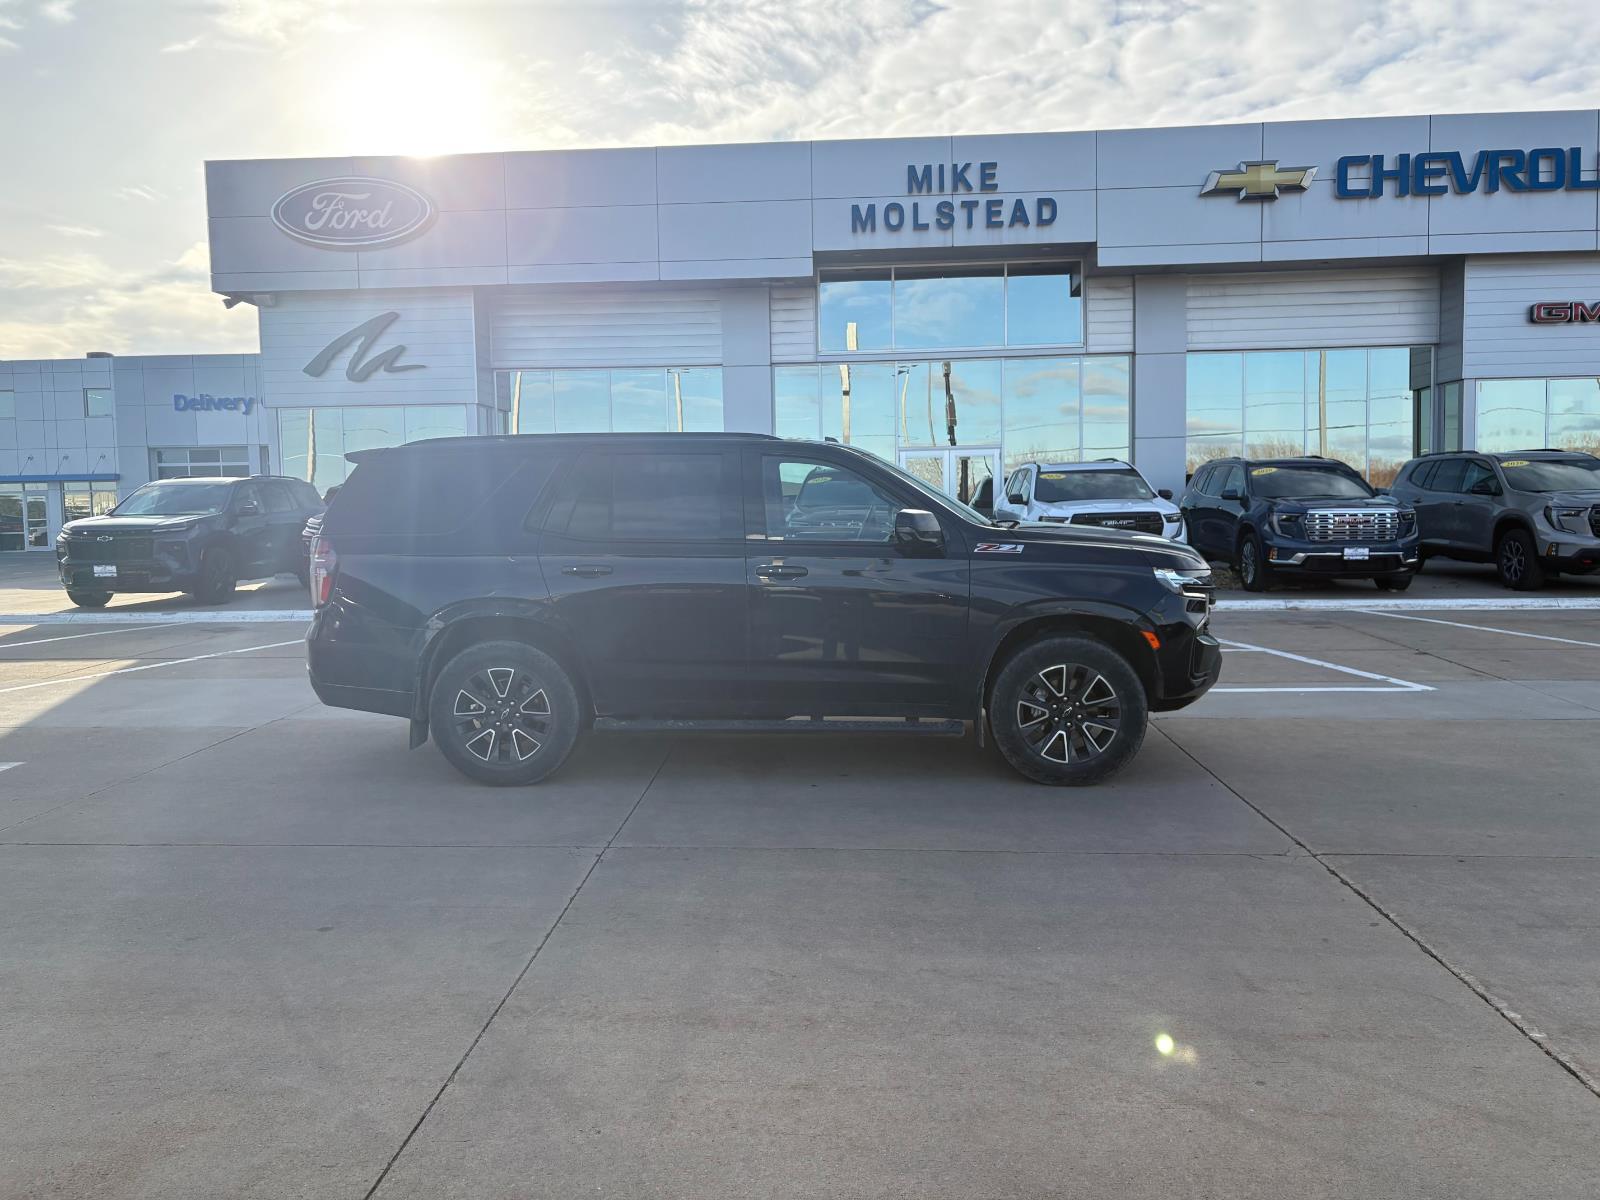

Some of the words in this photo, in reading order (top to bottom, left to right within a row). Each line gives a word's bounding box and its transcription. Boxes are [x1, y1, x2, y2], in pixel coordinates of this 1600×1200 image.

[907, 161, 999, 194] MIKE
[304, 192, 393, 230] Ford
[851, 197, 1058, 233] MOLSTEAD
[173, 393, 255, 415] Delivery
[974, 543, 1025, 553] Z71
